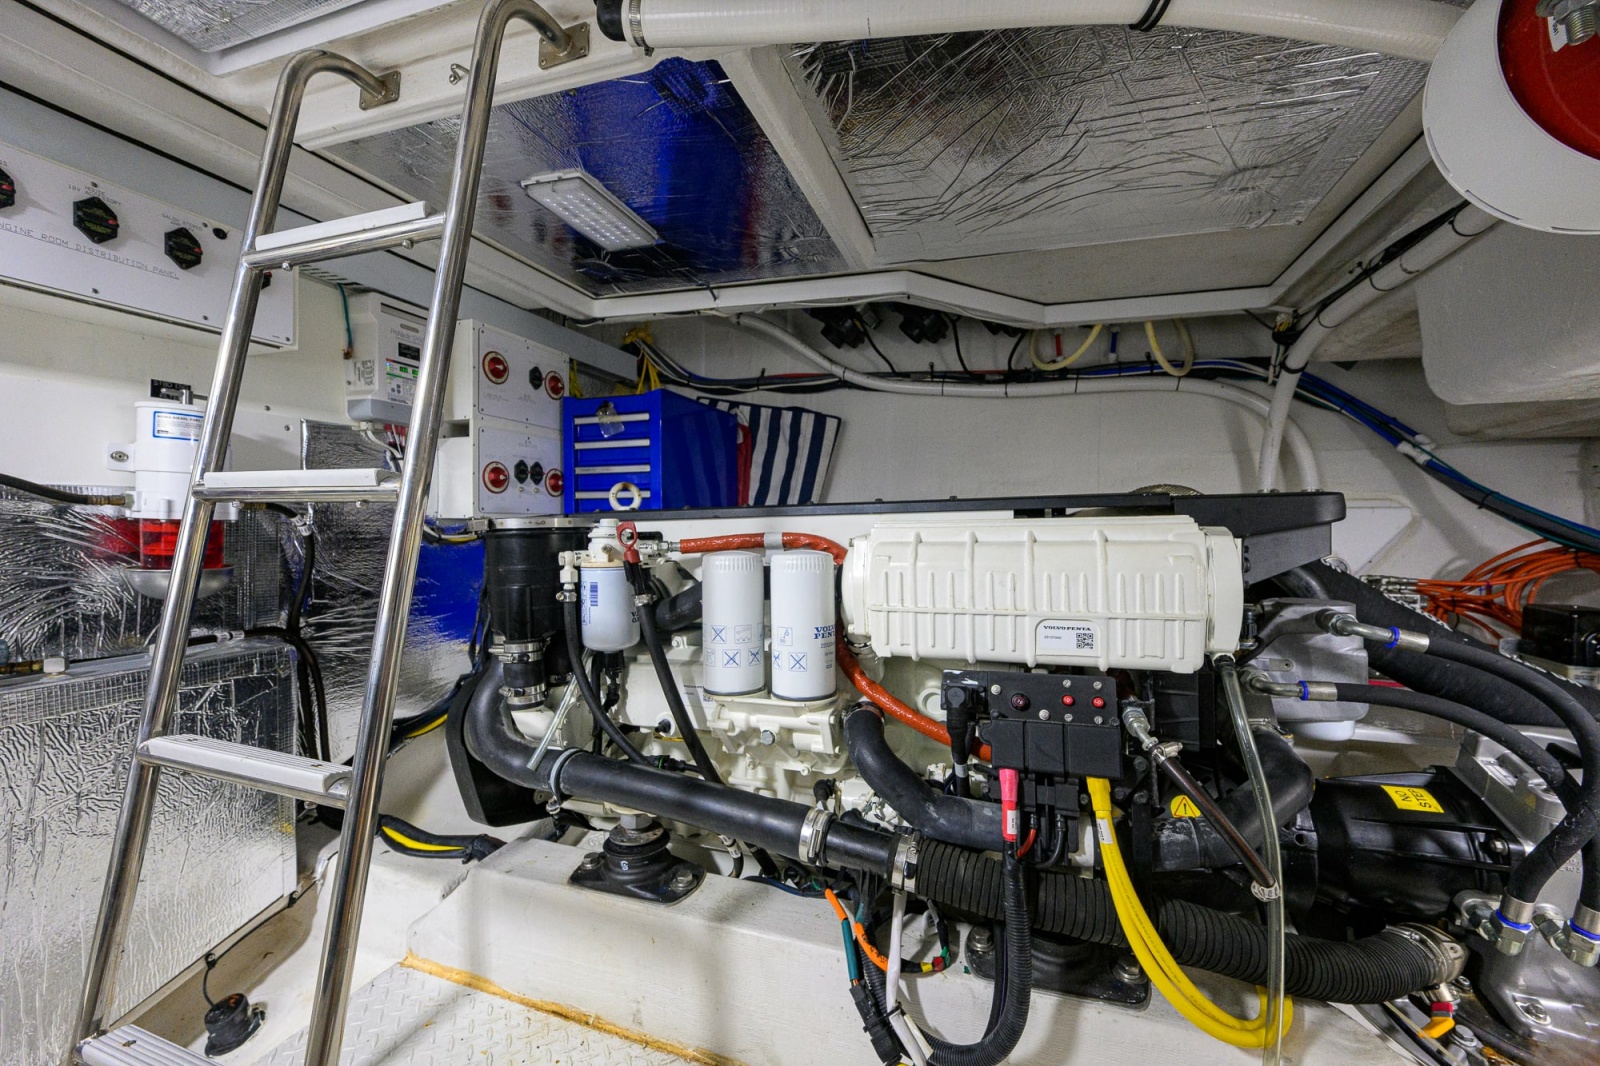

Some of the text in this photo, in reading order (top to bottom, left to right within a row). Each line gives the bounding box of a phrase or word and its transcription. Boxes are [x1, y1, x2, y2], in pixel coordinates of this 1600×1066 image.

[41, 233, 69, 247] ROOM
[75, 243, 148, 271] DISTRIBUTION
[153, 266, 179, 279] PANEL
[1395, 790, 1412, 802] NO
